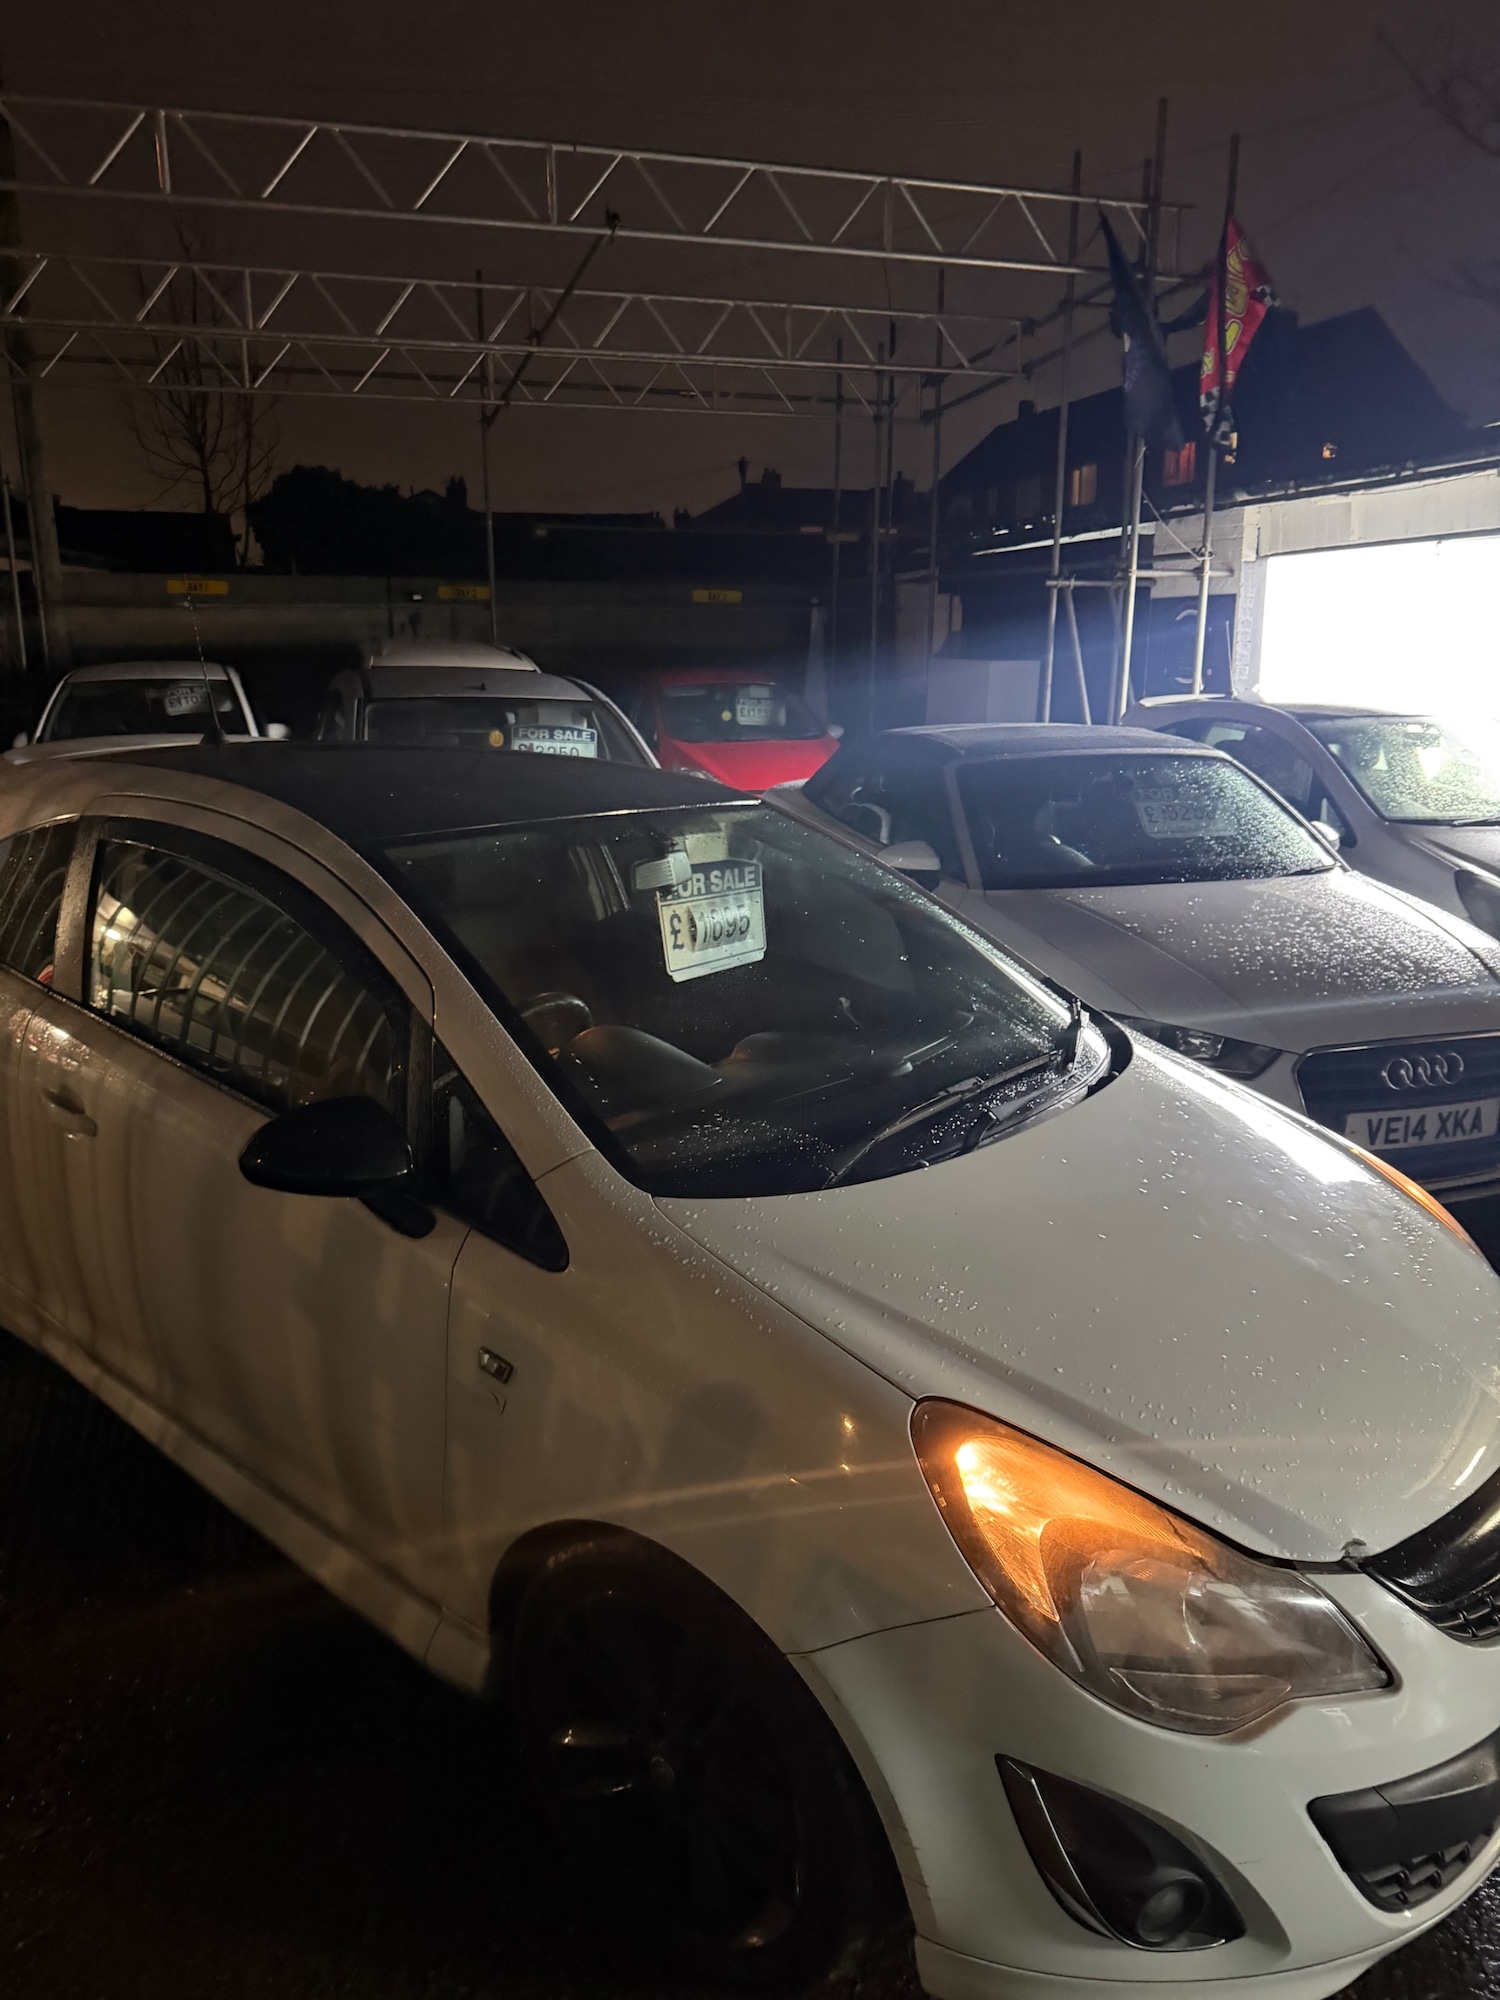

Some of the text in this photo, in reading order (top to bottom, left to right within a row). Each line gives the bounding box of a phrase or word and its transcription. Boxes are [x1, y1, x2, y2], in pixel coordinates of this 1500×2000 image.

[518, 728, 592, 741] FOR SALE
[667, 866, 755, 899] OR SALE
[1367, 1106, 1482, 1146] VE14 XKA
